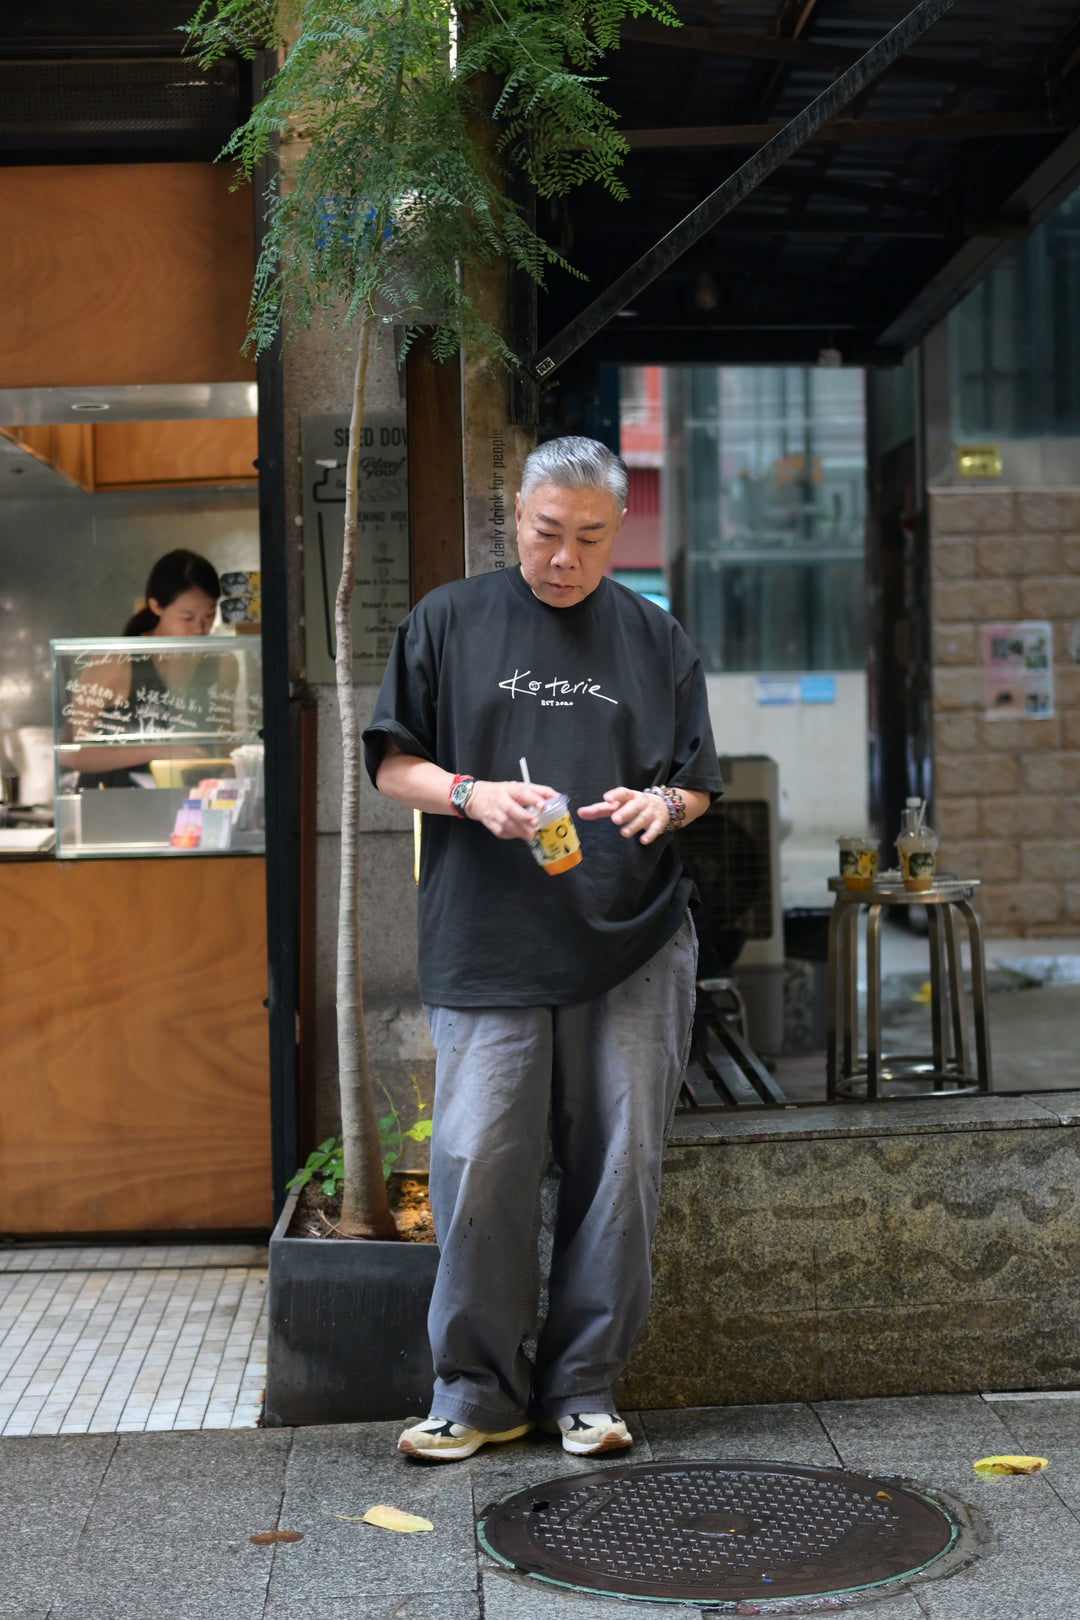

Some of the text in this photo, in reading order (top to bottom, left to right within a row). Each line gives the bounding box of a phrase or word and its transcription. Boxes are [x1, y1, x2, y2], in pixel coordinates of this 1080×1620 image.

[357, 511, 384, 522] ENING
[488, 429, 506, 568] a daily drink for people
[498, 669, 619, 705] Koterie
